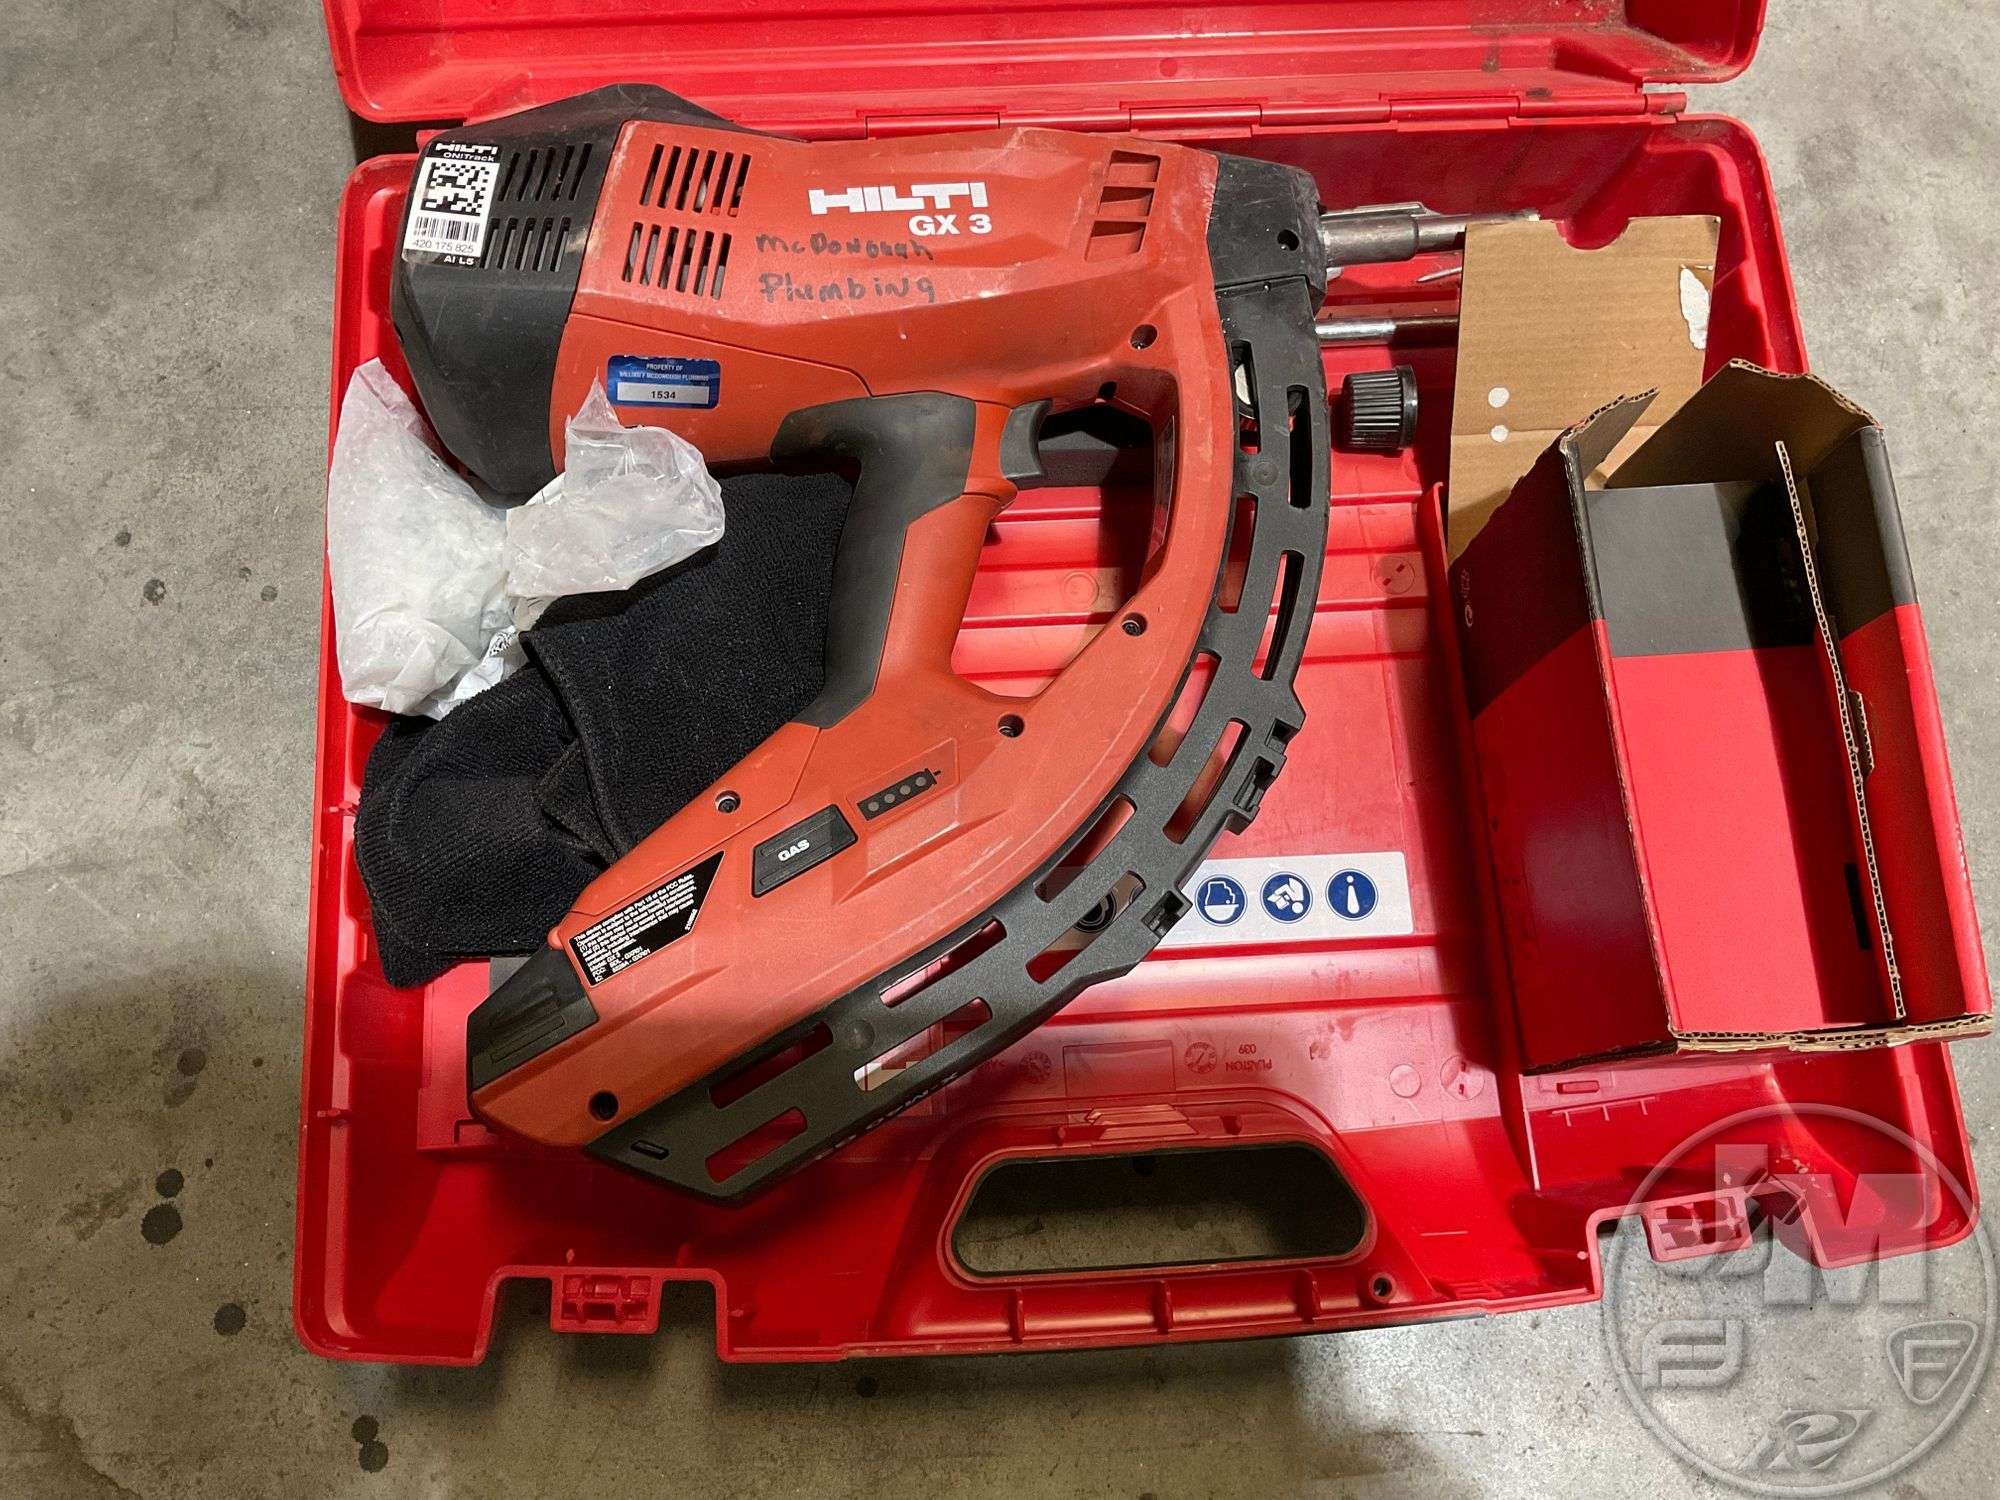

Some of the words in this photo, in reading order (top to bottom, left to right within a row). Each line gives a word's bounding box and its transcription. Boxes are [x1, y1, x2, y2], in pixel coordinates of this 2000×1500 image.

[436, 143, 498, 155] HILTI
[443, 152, 495, 162] ON!Track
[808, 181, 989, 216] HILTI
[908, 214, 960, 236] GX
[968, 213, 992, 234] 3
[413, 239, 432, 249] 420
[435, 241, 453, 251] 175
[455, 242, 474, 253] 825
[758, 272, 936, 303] Plumbing
[646, 363, 675, 371] PROPERTY
[651, 390, 676, 399] 1534
[777, 839, 810, 862] GAS
